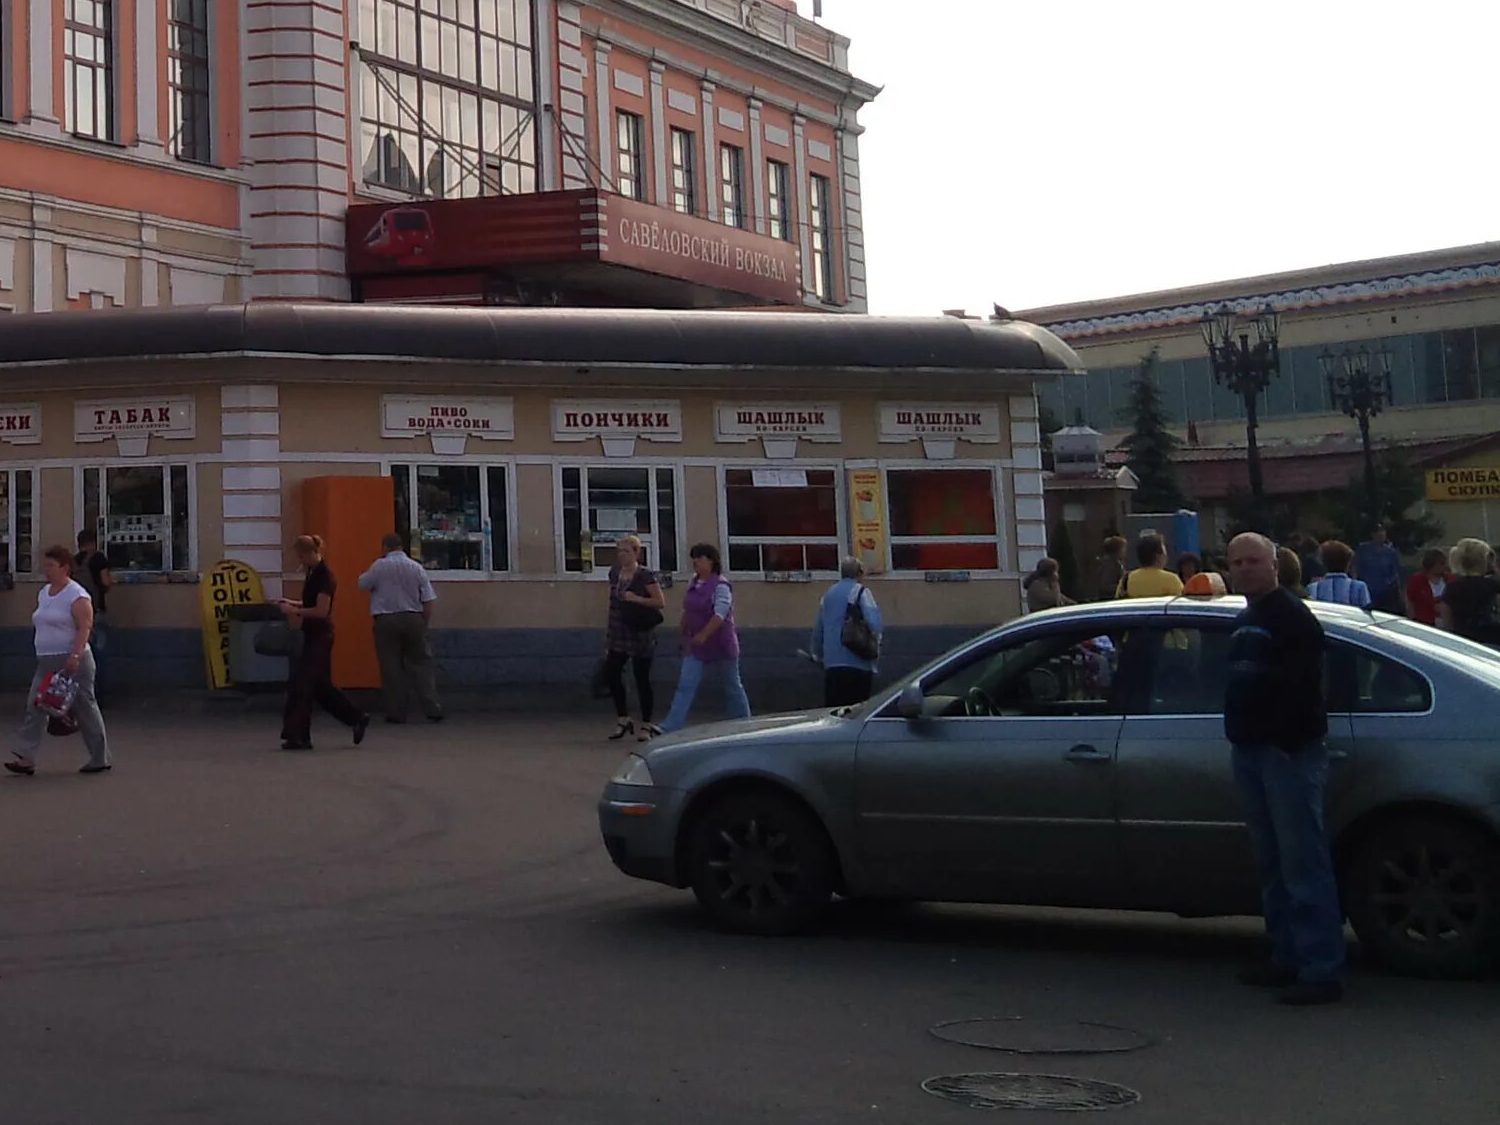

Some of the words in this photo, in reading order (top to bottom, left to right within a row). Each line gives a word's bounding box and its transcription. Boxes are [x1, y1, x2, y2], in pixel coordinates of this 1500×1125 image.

[619, 218, 730, 268] САВЁЛОВСКИЙ
[735, 247, 787, 282] ВОКЗАЛ
[94, 407, 170, 424] ТАБАК
[431, 406, 468, 417] ПИВО
[737, 411, 825, 425] ШАШЛЫК
[896, 412, 982, 425] ШАШЛЫК
[565, 412, 669, 427] ПОНЧИКИ
